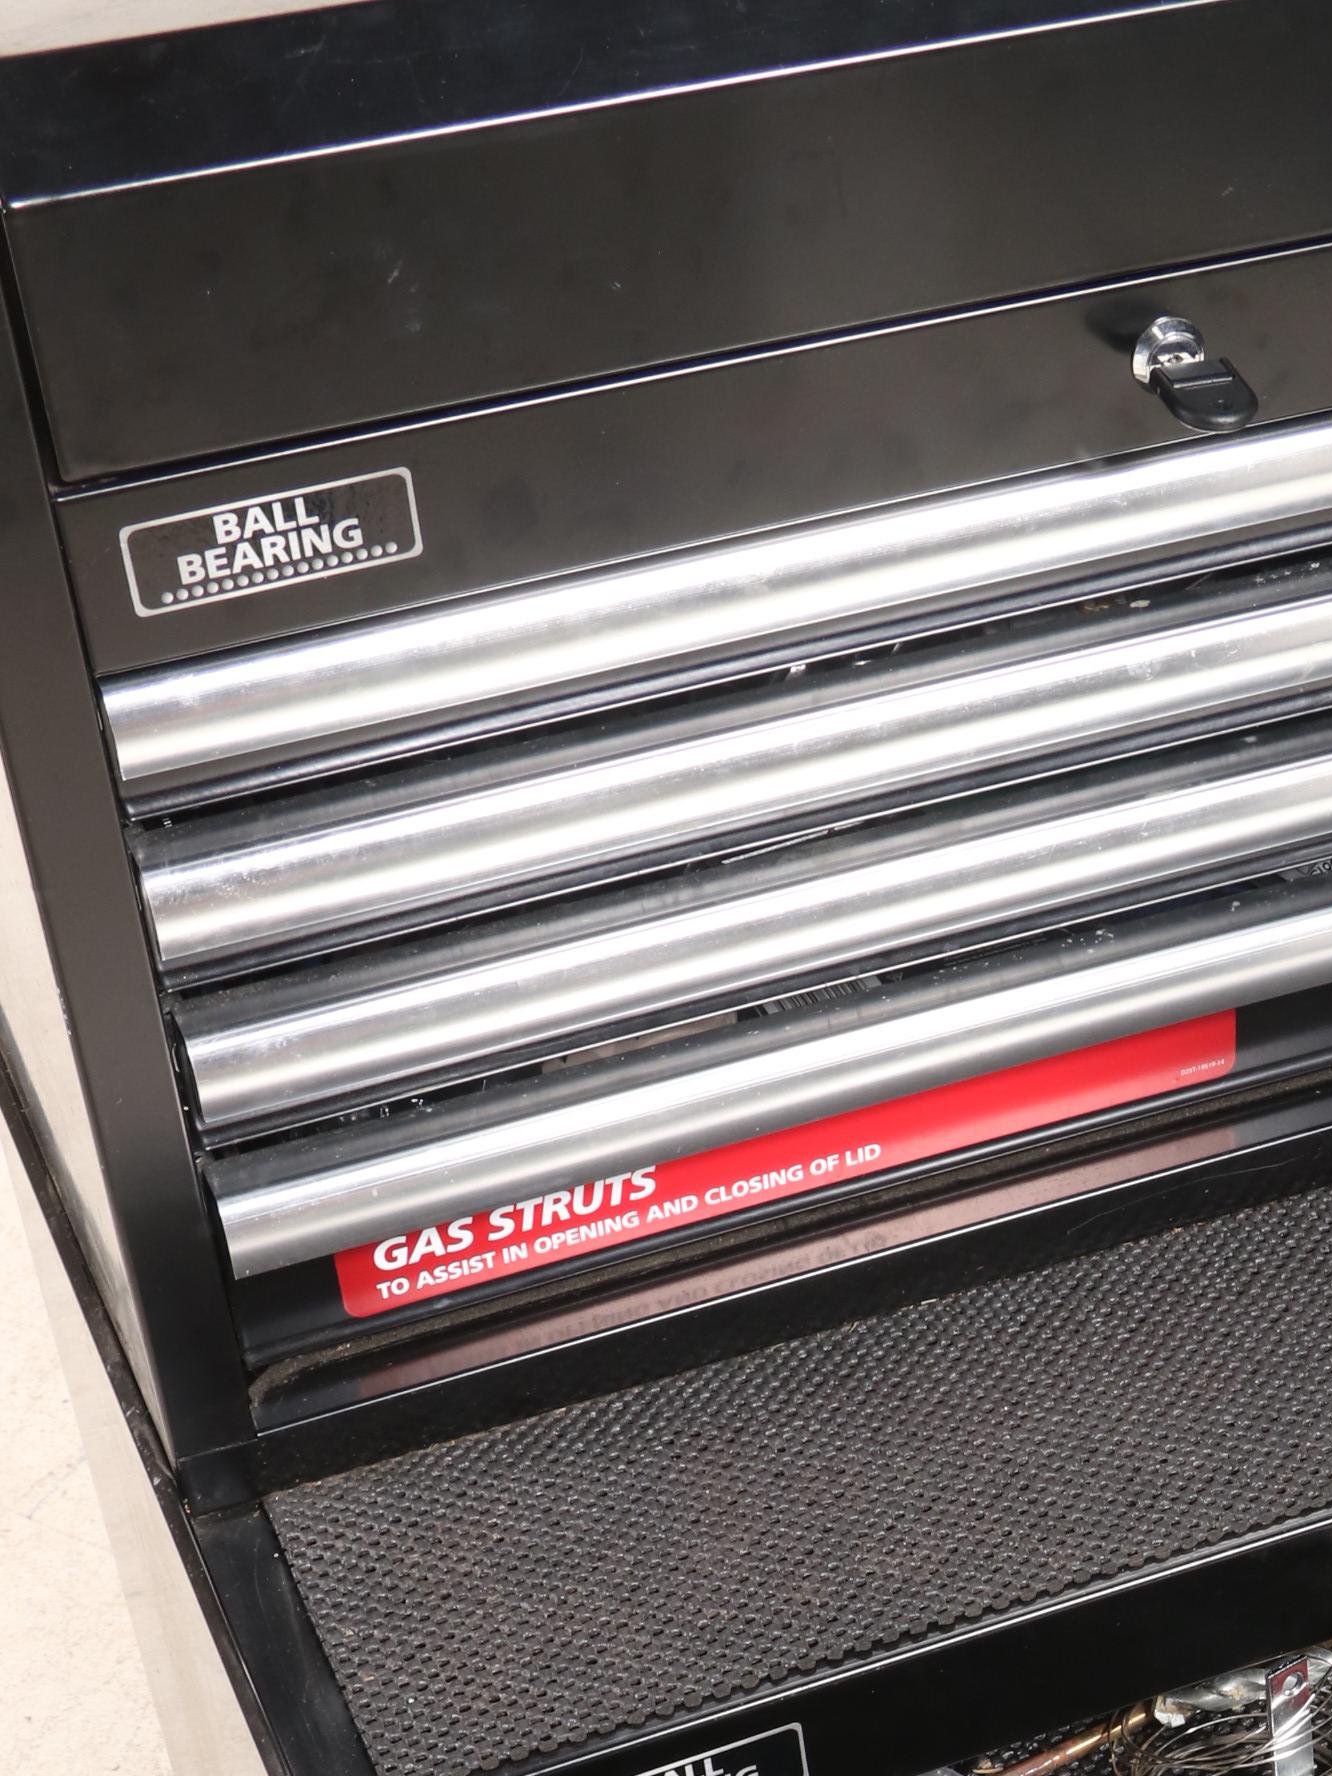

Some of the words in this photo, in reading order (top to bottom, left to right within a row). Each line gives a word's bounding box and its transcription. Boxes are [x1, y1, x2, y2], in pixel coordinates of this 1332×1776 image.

[176, 518, 364, 586] BEARING
[212, 497, 320, 544] BALL
[372, 1216, 475, 1271] GAS
[487, 1165, 656, 1241] STRUTS
[376, 1277, 411, 1300] TO
[416, 1251, 496, 1290] ASSIST
[502, 1242, 529, 1265] IN
[533, 1209, 641, 1254] OPENING
[646, 1193, 699, 1224] AND
[703, 1163, 804, 1206] CLOSING
[809, 1153, 841, 1177] OF
[845, 1143, 882, 1167] LID
